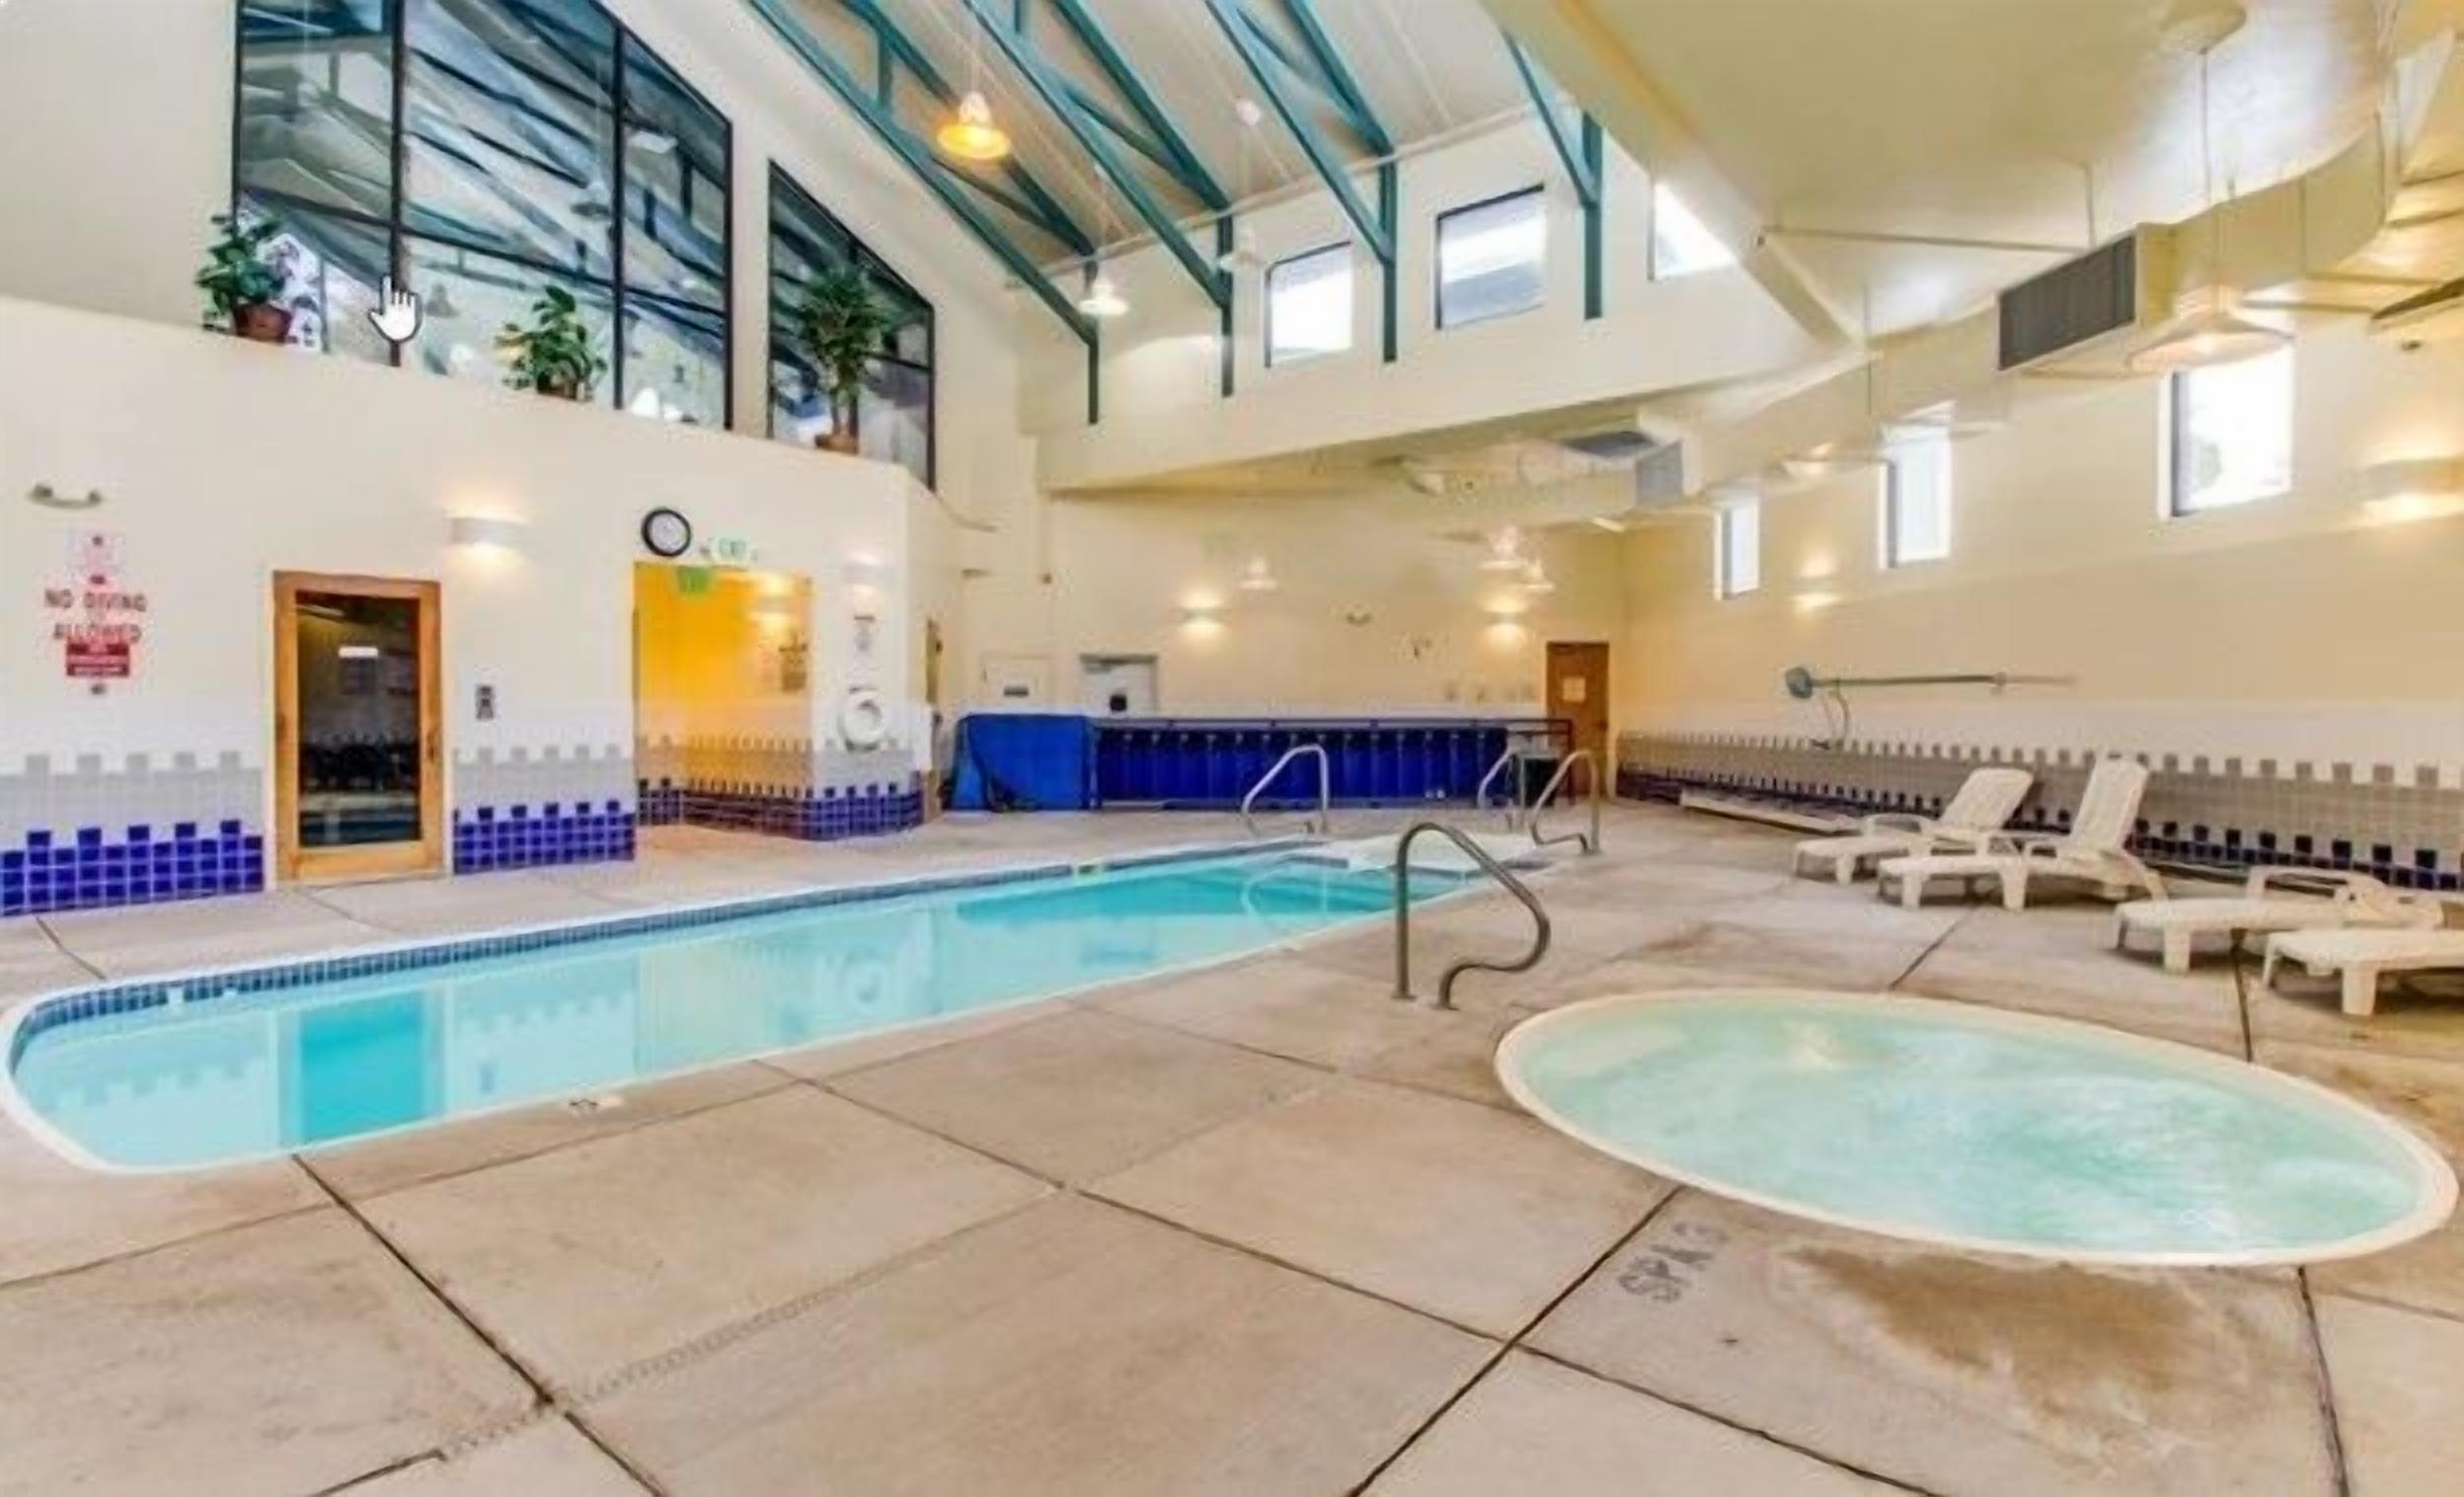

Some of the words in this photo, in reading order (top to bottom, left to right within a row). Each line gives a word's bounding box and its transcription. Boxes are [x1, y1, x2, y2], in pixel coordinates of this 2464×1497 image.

[44, 589, 74, 608] NO
[83, 591, 147, 611] DIVING
[53, 623, 142, 643] ALLOWED
